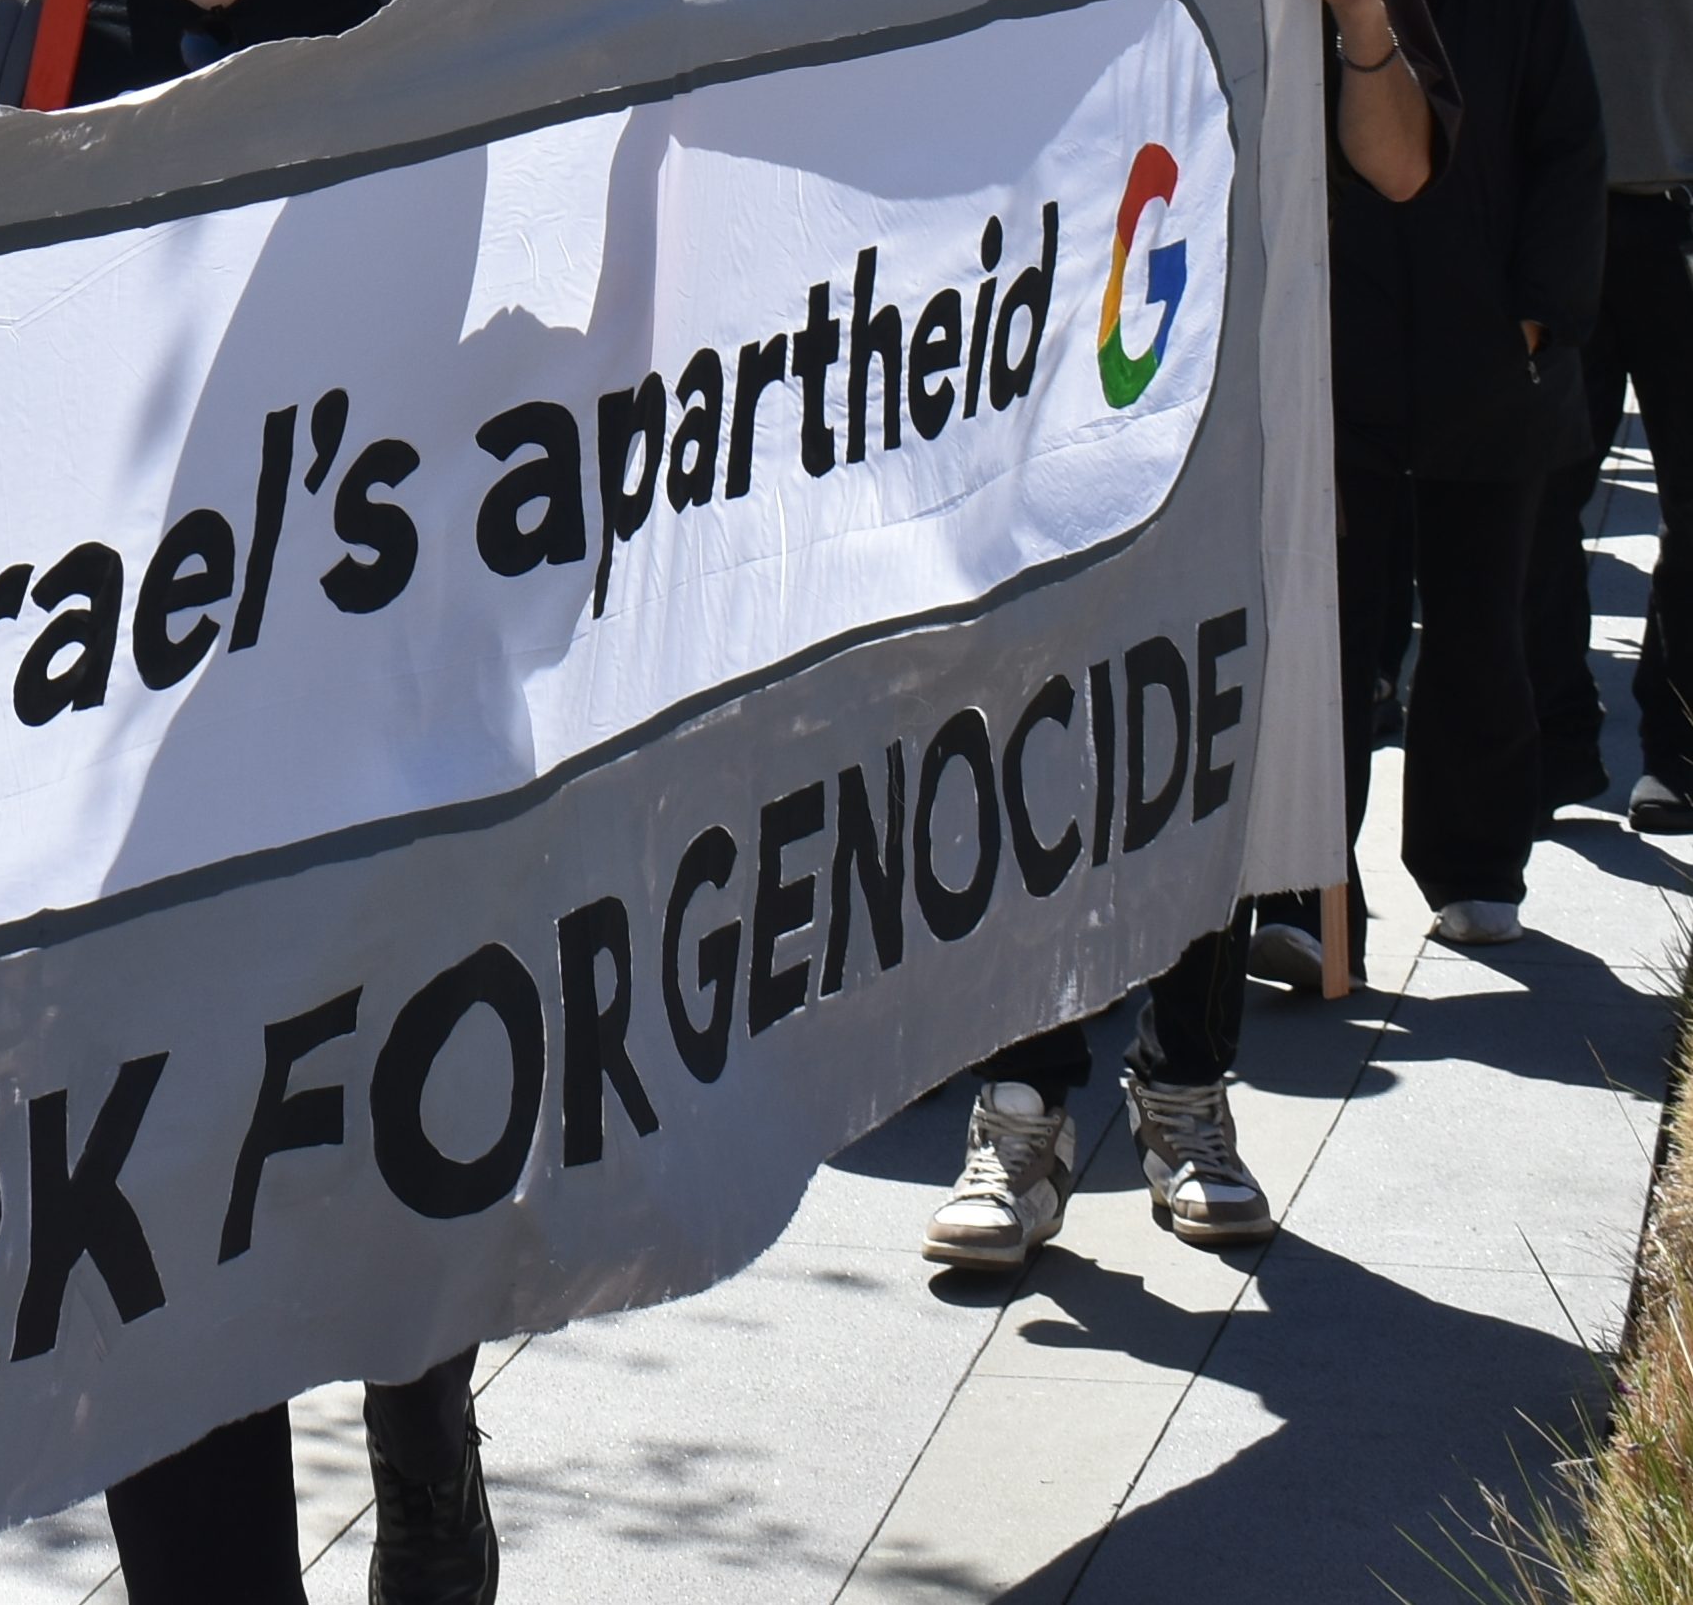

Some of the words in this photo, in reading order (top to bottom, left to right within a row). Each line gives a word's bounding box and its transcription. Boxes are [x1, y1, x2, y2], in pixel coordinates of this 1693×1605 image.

[474, 201, 1060, 621] apartheid
[1097, 141, 1187, 409] G
[217, 895, 661, 1267] FOR
[661, 606, 1249, 1086] GENOCIDE
